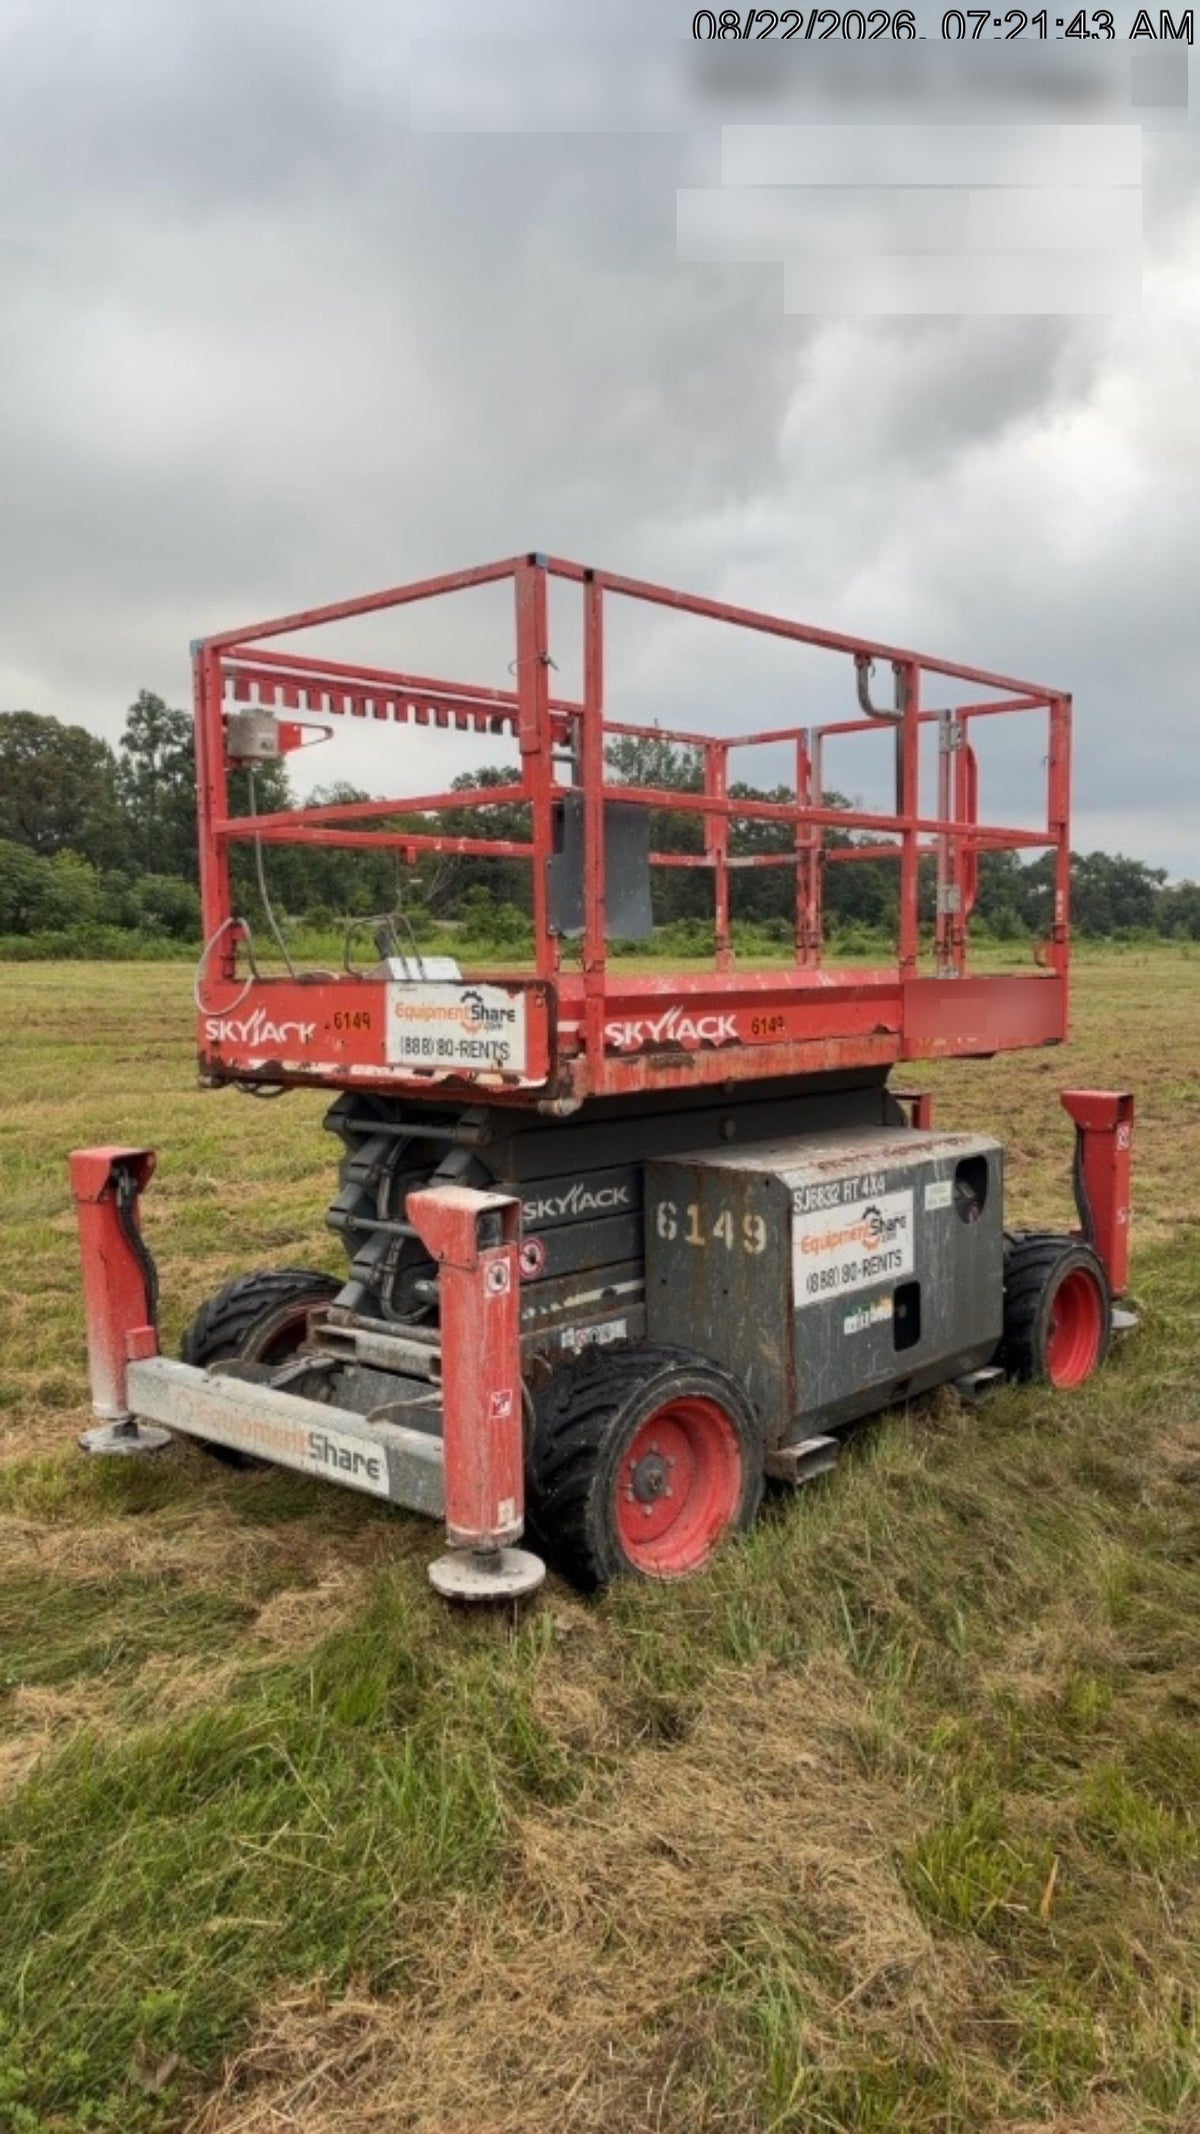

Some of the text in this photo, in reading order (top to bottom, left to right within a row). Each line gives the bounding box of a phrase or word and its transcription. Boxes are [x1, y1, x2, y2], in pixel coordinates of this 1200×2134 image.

[205, 1008, 317, 1046] SKYJACK
[333, 1011, 371, 1031] 6149
[395, 1002, 516, 1022] EquipmentShare
[604, 1005, 739, 1046] SKYJACK
[436, 1038, 511, 1061] 80-RENTS
[523, 1182, 630, 1221] SKYJACK
[656, 1200, 768, 1255] 6149
